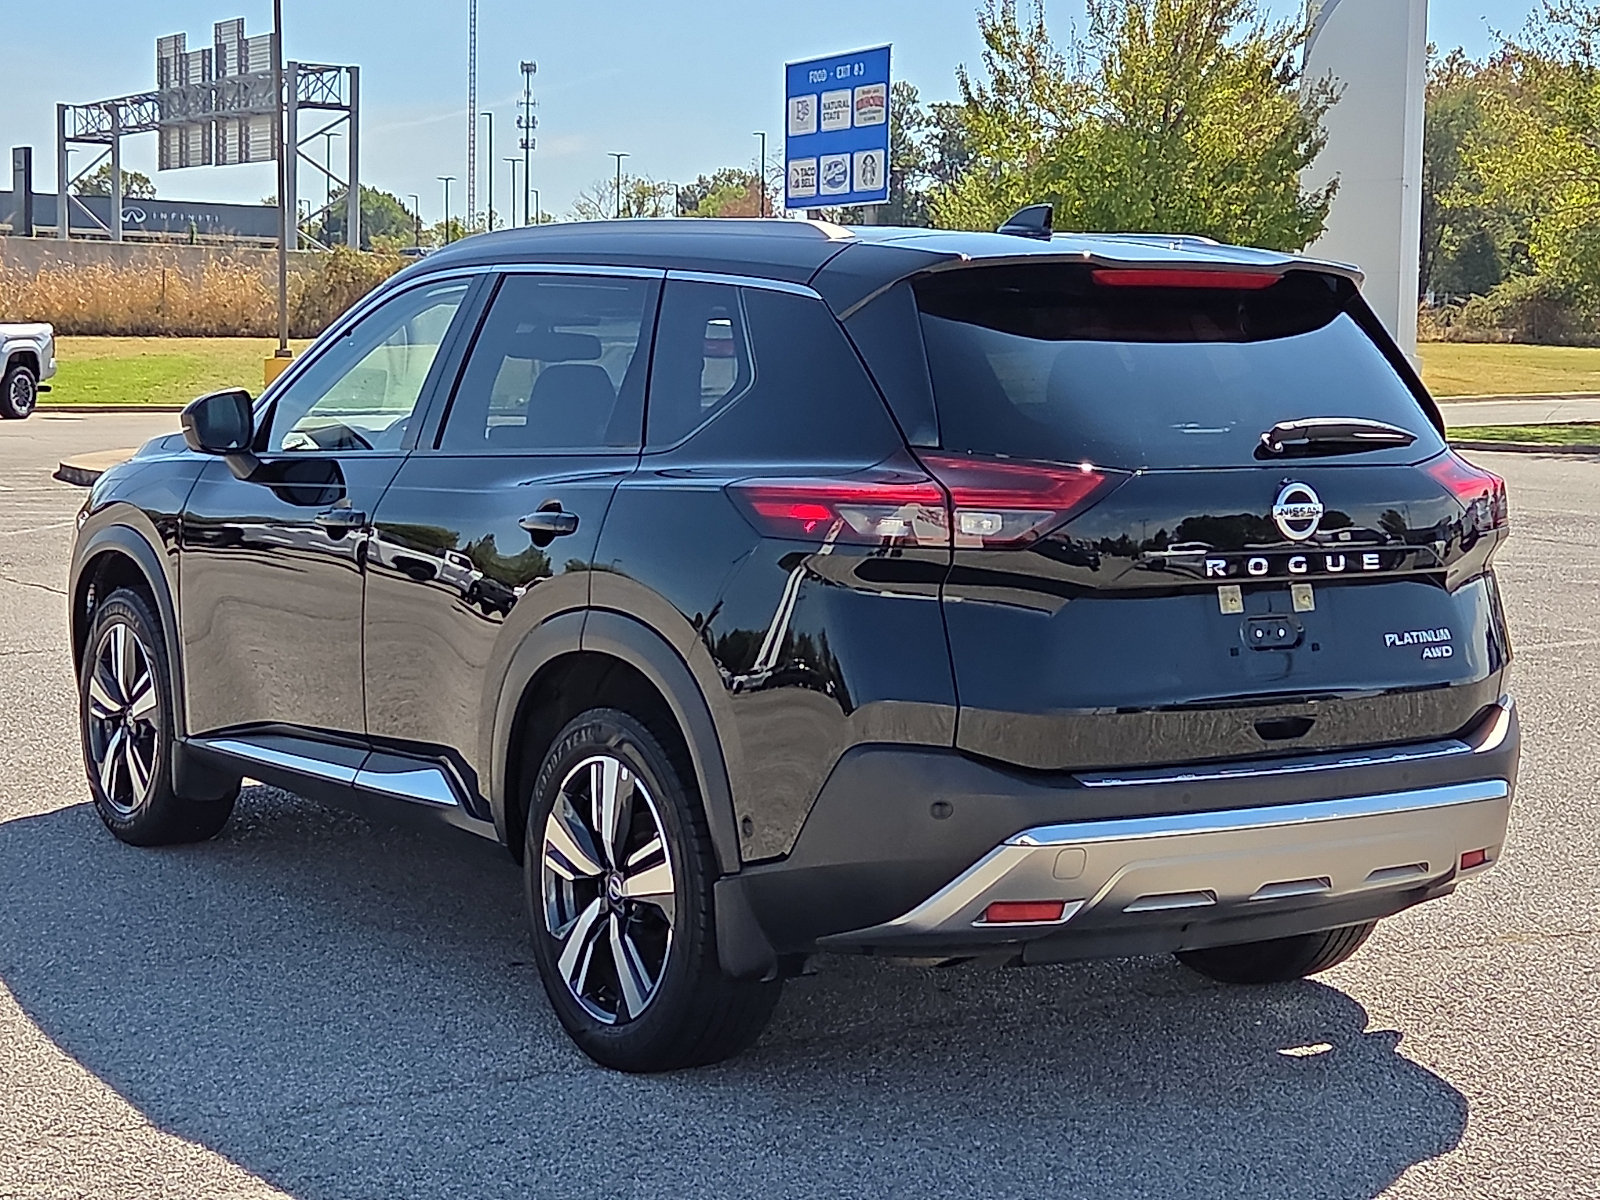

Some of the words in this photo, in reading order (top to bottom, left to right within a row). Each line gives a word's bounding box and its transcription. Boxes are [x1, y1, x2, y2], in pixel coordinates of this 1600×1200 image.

[809, 68, 827, 83] FOOD
[822, 100, 850, 111] NATURAL
[822, 111, 841, 121] STATE
[800, 166, 816, 177] TACO
[800, 177, 816, 189] BELL
[152, 211, 220, 223] INFINITI
[1279, 506, 1321, 518] NISSAN
[1205, 553, 1381, 577] ROGUE
[1384, 628, 1452, 648] PLATINUM
[1422, 645, 1454, 660] AWD
